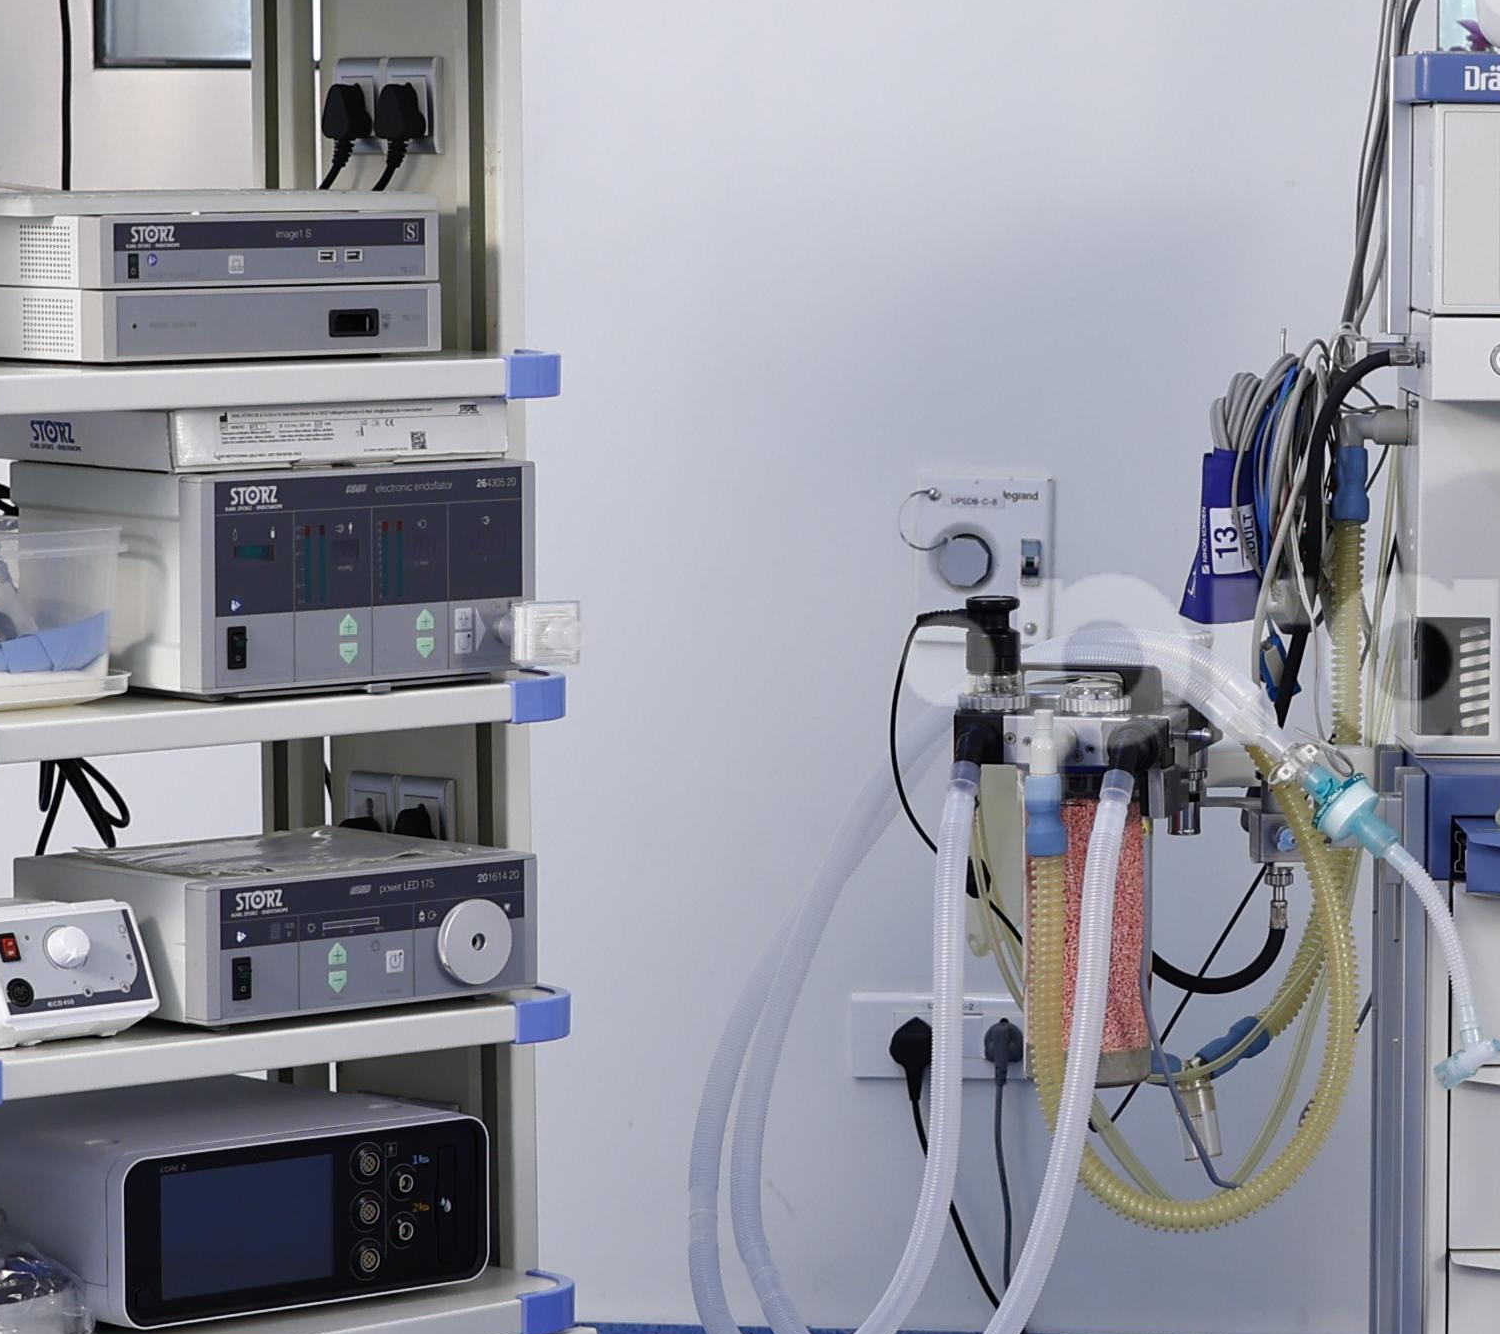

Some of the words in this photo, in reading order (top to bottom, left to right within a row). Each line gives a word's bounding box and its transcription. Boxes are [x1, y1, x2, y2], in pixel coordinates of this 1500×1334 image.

[131, 226, 175, 242] STORZ
[30, 420, 75, 444] STORZ
[230, 486, 278, 505] STORZ
[375, 482, 413, 493] electronic
[1213, 526, 1238, 559] 13
[509, 870, 520, 880] 20
[380, 883, 401, 894] power
[404, 879, 418, 891] LED
[421, 879, 434, 889] 175
[235, 889, 283, 911] STORZ
